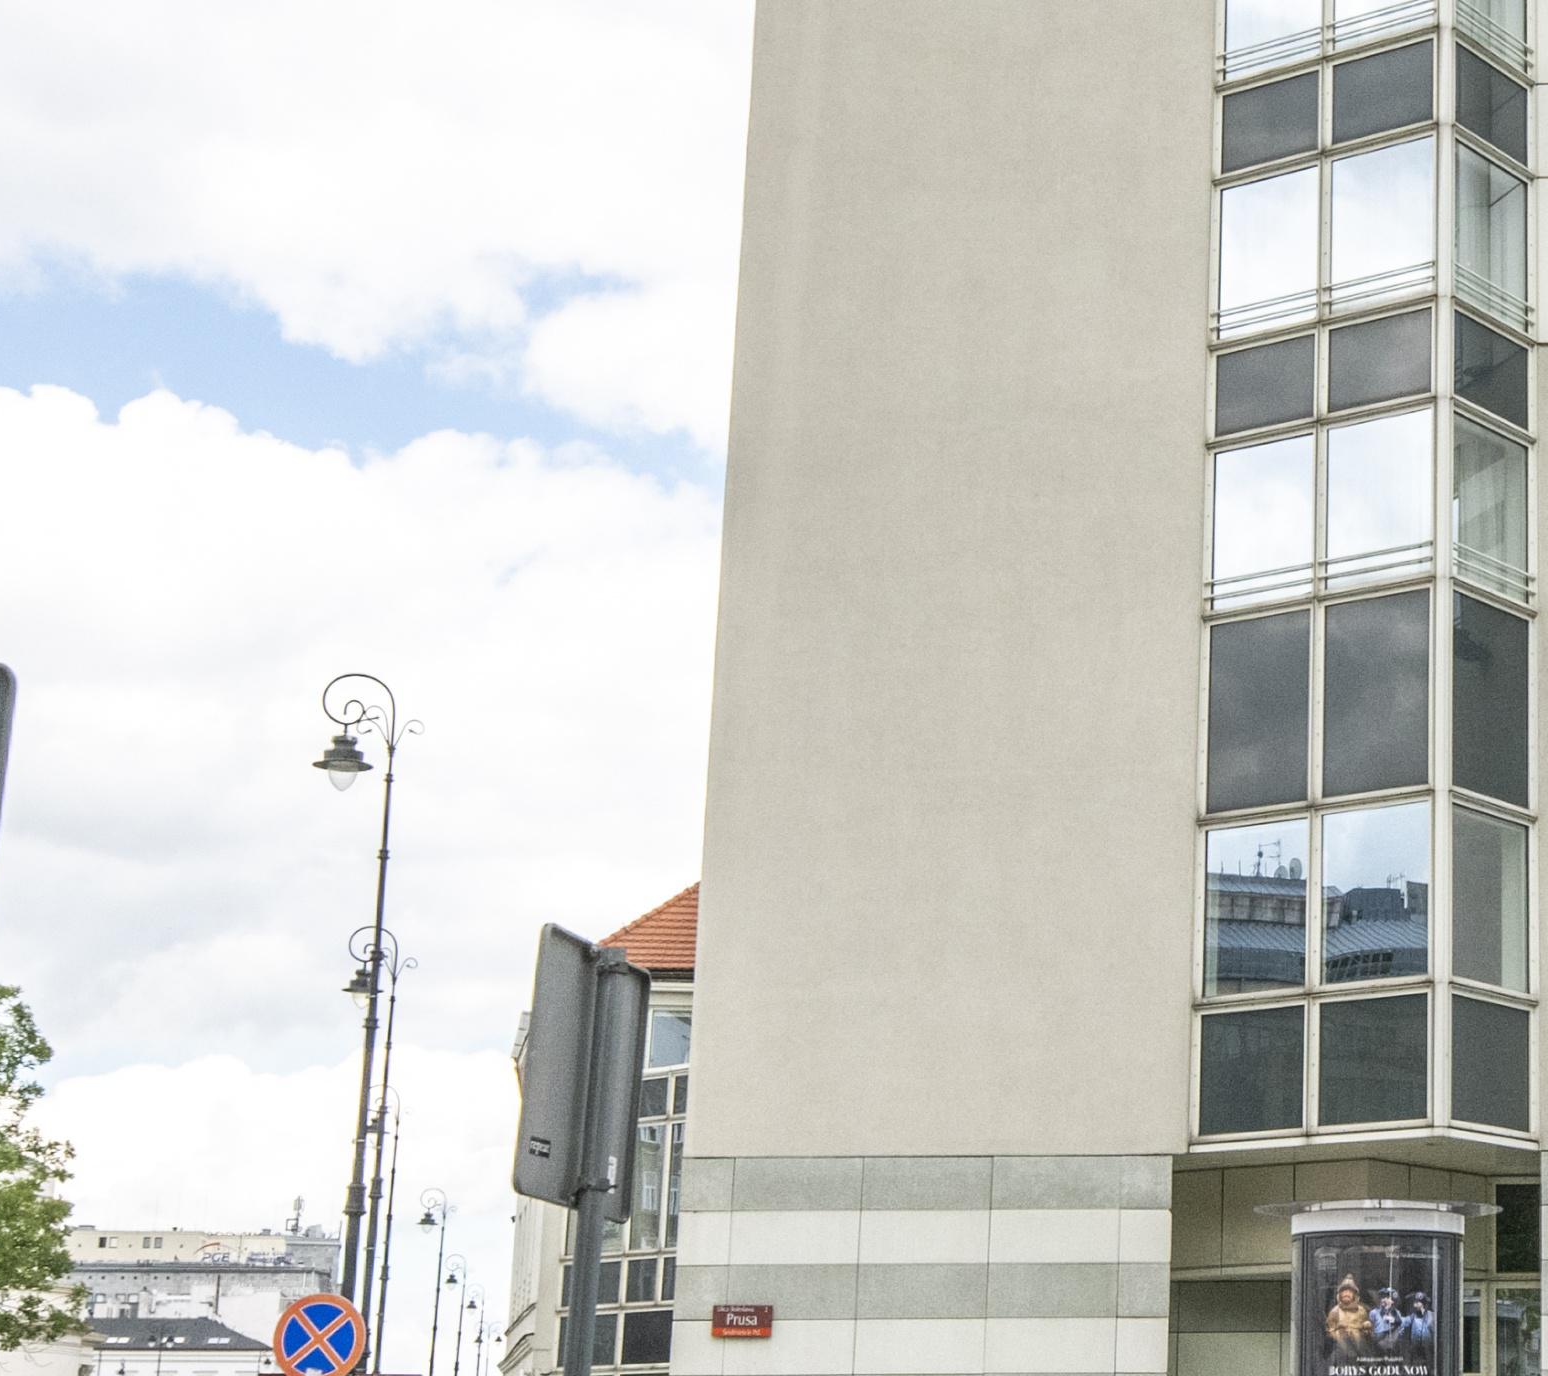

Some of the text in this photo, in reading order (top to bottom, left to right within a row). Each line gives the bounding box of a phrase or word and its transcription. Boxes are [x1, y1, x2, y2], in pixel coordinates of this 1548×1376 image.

[202, 1252, 230, 1263] PGE
[726, 1313, 758, 1326] Prusa
[1329, 1365, 1428, 1376] BORYS GODUNOW
